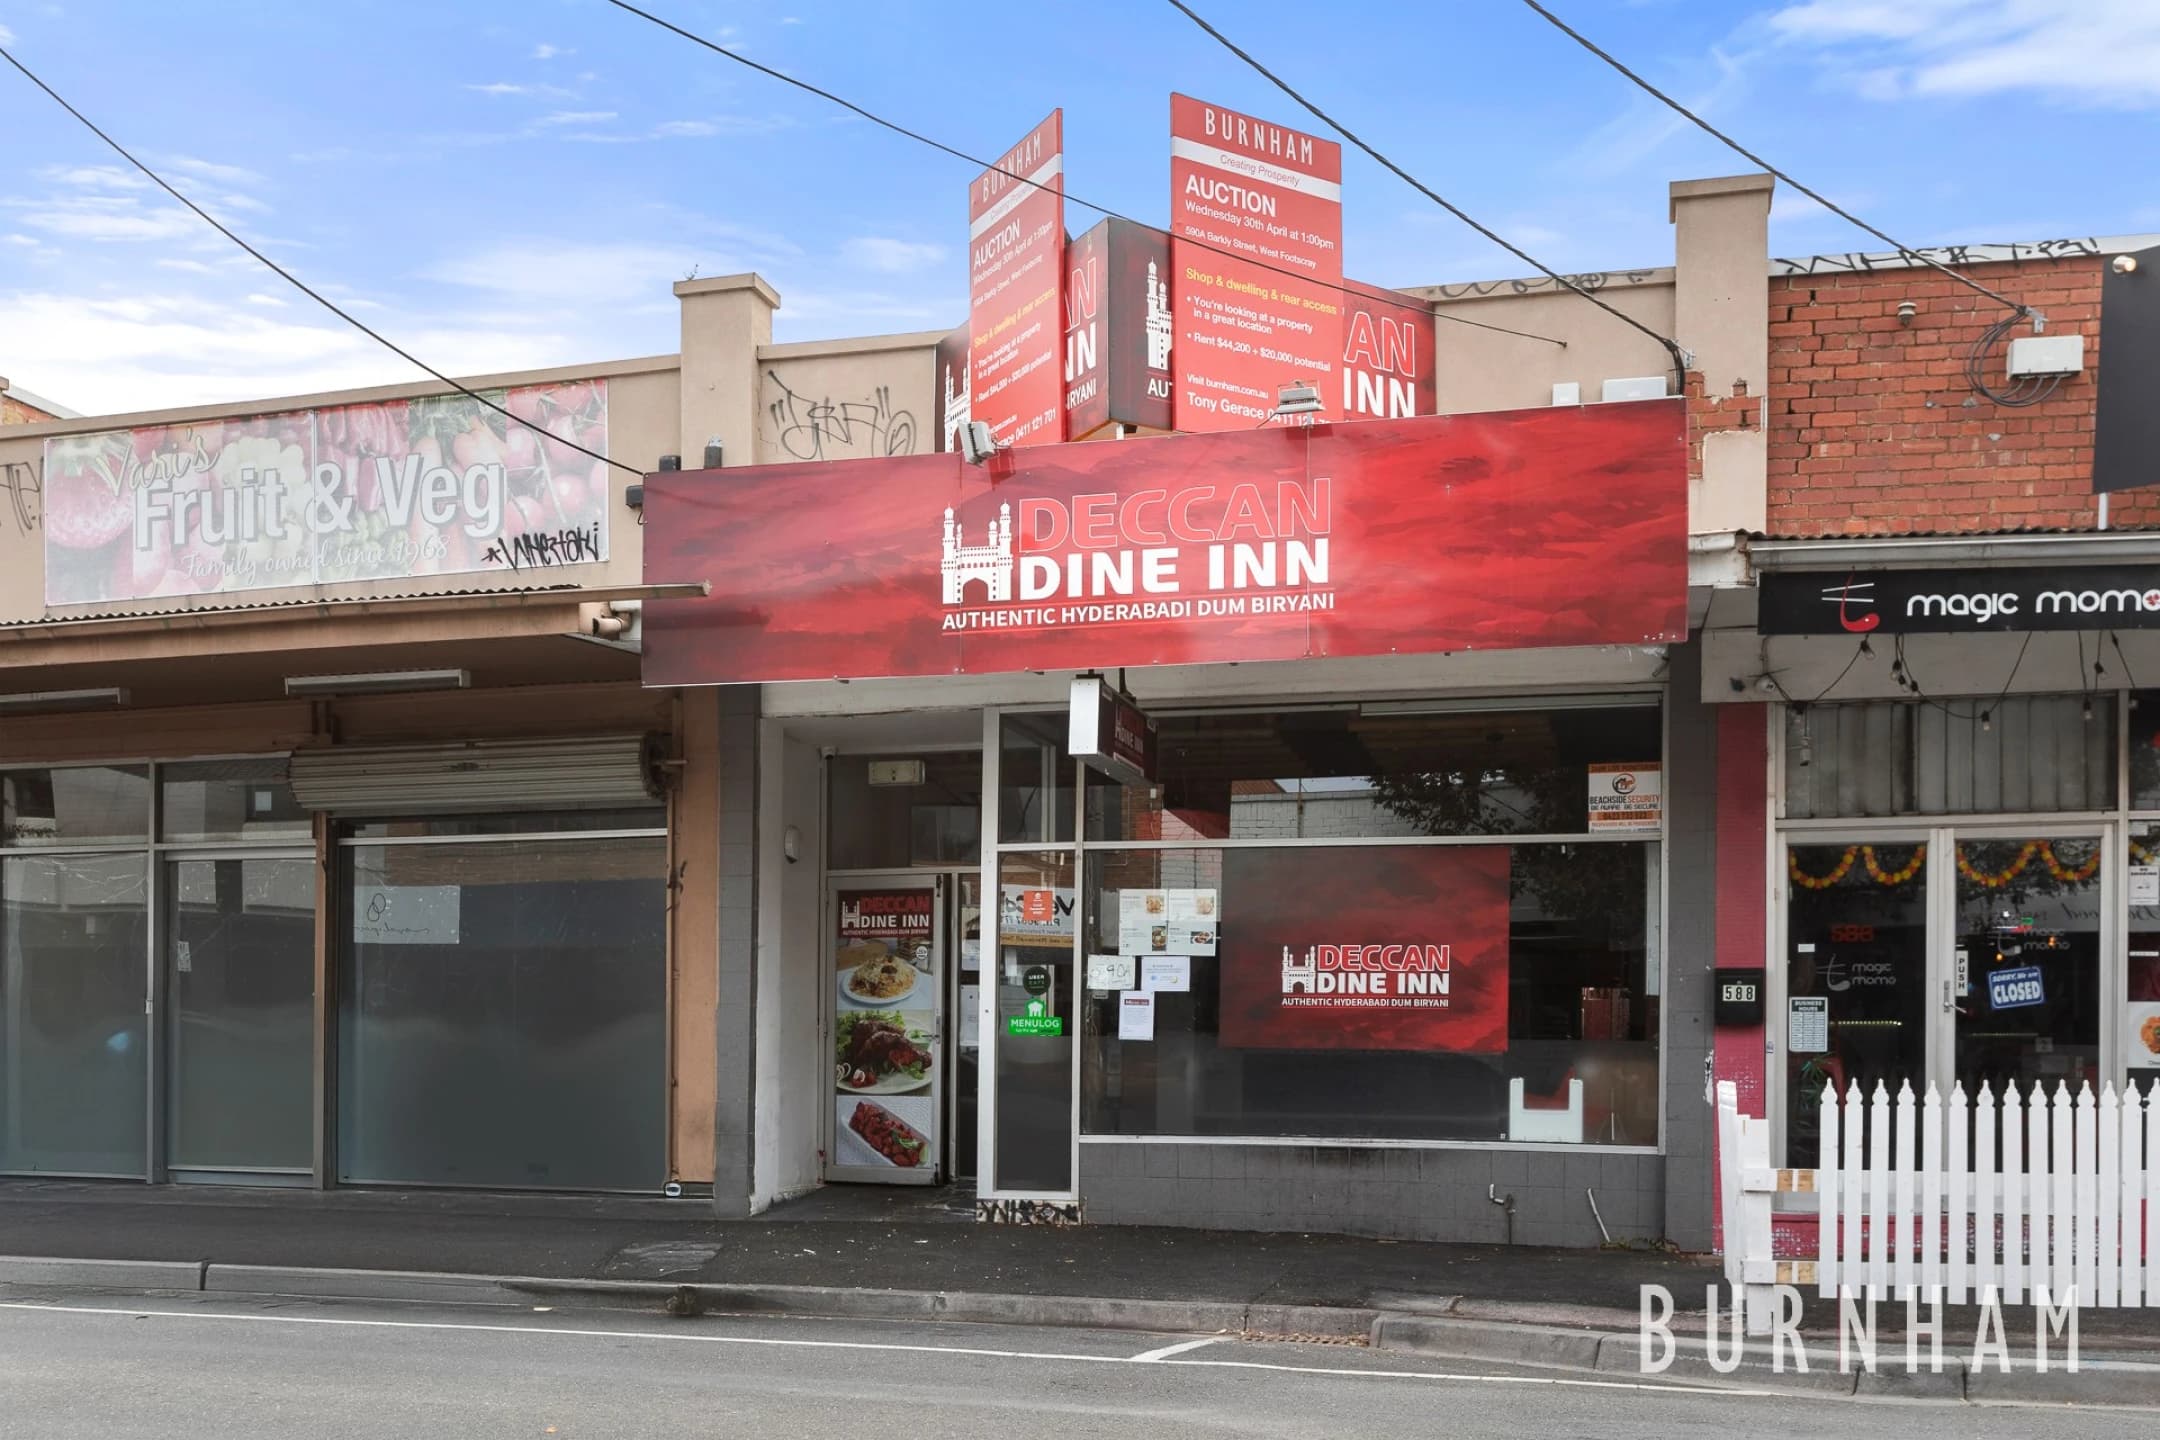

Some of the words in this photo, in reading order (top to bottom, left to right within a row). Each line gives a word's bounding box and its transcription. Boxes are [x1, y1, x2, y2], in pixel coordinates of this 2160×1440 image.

[1205, 107, 1313, 166] BURNHAM
[982, 132, 1041, 203] BURNHAM
[1220, 154, 1258, 176] Creating
[1258, 164, 1302, 188] Prosperity
[1185, 173, 1277, 218] AUCTION
[1185, 199, 1243, 228] Wednesday
[1243, 216, 1265, 232] 30th
[1266, 221, 1289, 240] April
[1290, 229, 1300, 241] at
[1301, 231, 1335, 251] 1:00pm
[973, 217, 1021, 271] AUCTION
[1207, 230, 1232, 248] Barkly
[1233, 237, 1258, 254] Street,
[1259, 245, 1280, 259] West
[1280, 250, 1317, 270] Footscray
[1186, 267, 1214, 285] Shop
[1215, 275, 1224, 288] &
[1226, 277, 1269, 301] dwelling
[1270, 287, 1279, 301] &
[1280, 292, 1301, 306] rear
[1302, 297, 1338, 316] access
[1193, 295, 1224, 312] You're
[1225, 303, 1258, 322] looking
[1258, 311, 1269, 321] at
[1269, 315, 1276, 324] a
[1277, 316, 1314, 335] property
[1193, 308, 1203, 319] in
[1203, 311, 1211, 321] a
[1212, 312, 1237, 328] great
[1237, 318, 1273, 335] location
[1194, 332, 1216, 347] Rent
[1216, 337, 1251, 355] $44,200
[1259, 346, 1293, 364] $20,000
[1294, 353, 1332, 372] potential
[1066, 377, 1097, 412] IRYANI
[1186, 372, 1205, 386] Visit
[1205, 377, 1270, 400] burnham.com.au
[1044, 407, 1057, 425] 701
[1186, 392, 1218, 413] Tony
[1220, 398, 1264, 420] Gerace
[1266, 408, 1295, 426] 0411
[95, 426, 221, 498] Vari's
[135, 464, 289, 552] Fruit
[304, 460, 354, 534] &
[375, 452, 505, 538] Veg
[1018, 477, 1331, 554] DECCAN
[180, 551, 257, 585] Family
[264, 542, 331, 572] owned
[334, 541, 390, 568] since
[388, 535, 449, 567] 1968
[1019, 547, 1180, 600] DINE
[1208, 538, 1330, 590] INN
[942, 608, 1056, 631] AUTHENTIC
[1061, 600, 1192, 624] HYDERABADI
[1197, 596, 1246, 617] DUM
[1251, 592, 1335, 615] BIRYANI
[1906, 592, 2019, 623] magic
[860, 915, 898, 928] DINE
[902, 914, 930, 928] INN
[1317, 944, 1450, 972] DECCAN
[1851, 962, 1892, 974] magic
[1957, 957, 1966, 990] PUSH
[1317, 972, 1387, 994] DINE
[1397, 972, 1450, 994] INN
[1724, 986, 1754, 1001] 588
[1851, 975, 1897, 985] momo
[1993, 980, 2041, 1004] CLOSED
[1282, 998, 1333, 1007] AUTHENTIC
[1333, 998, 1390, 1007] HYDERABADI
[1391, 998, 1412, 1007] DUM
[1413, 998, 1449, 1008] BIRYANI
[1010, 1018, 1060, 1028] MENULOG
